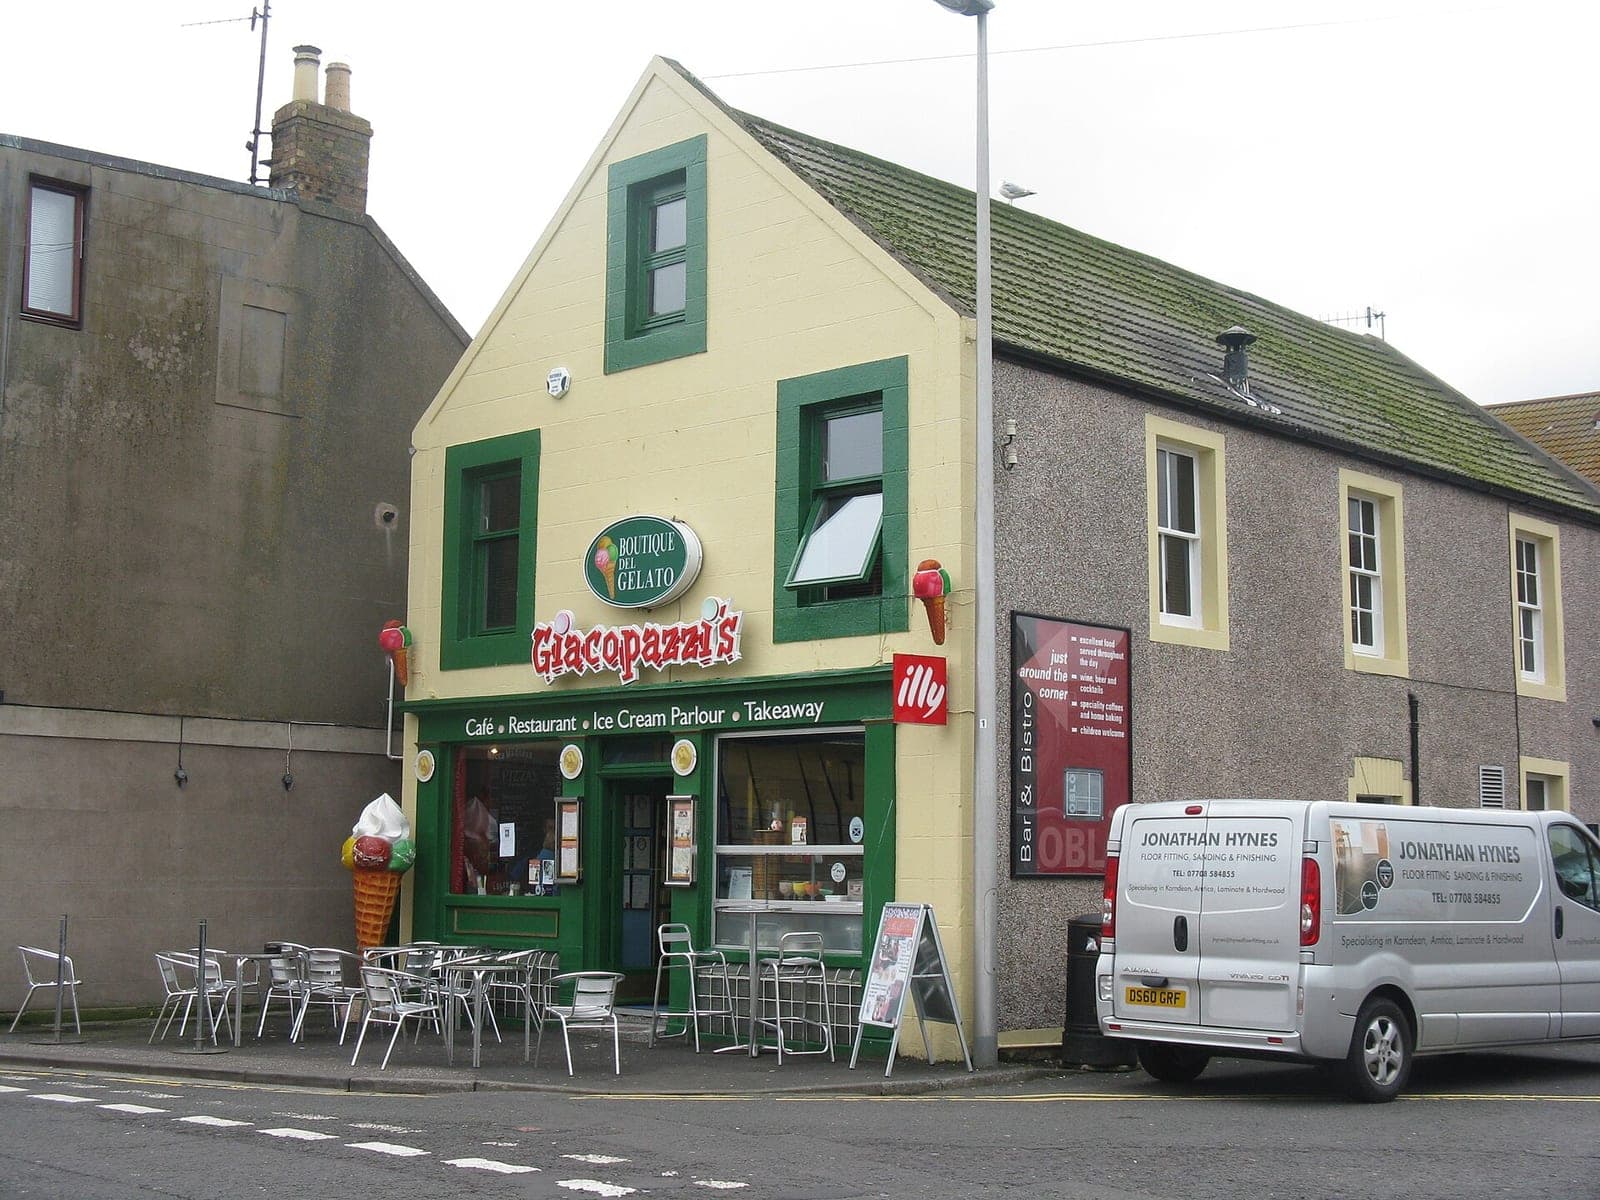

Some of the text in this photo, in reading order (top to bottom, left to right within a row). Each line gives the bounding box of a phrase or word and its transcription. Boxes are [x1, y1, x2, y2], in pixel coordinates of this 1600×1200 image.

[619, 532, 675, 557] BOUTIQUE
[618, 557, 636, 570] DEL
[617, 567, 674, 591] GELATO
[1080, 636, 1115, 648] excellent food
[1050, 649, 1068, 665] just
[1080, 648, 1124, 660] served throughout
[1080, 658, 1098, 669] the day
[1020, 667, 1068, 682] around the
[1095, 675, 1106, 684] beer
[1107, 676, 1117, 685] and
[897, 664, 945, 718] illy
[1039, 687, 1068, 700] corner
[1080, 685, 1103, 694] cocktails
[1080, 701, 1105, 711] speciality
[465, 701, 824, 736] Café Restaurant Ice Cream Parlour Takeaway
[1080, 711, 1122, 724] and home baking
[1080, 726, 1125, 737] children welcome
[1021, 691, 1032, 862] Bar & Bistro
[1141, 832, 1278, 847] JONATHAN HYNES
[1038, 826, 1105, 869] OBL
[1399, 842, 1521, 864] JONATHAN HYNES
[1140, 853, 1162, 861] FLOOR
[1192, 853, 1227, 861] SANDING
[1228, 853, 1235, 861] &
[1236, 854, 1277, 862] FINISHING
[1172, 869, 1186, 877] TEL:
[1209, 870, 1235, 878] 584855
[1402, 869, 1425, 880] FLOOR
[1454, 870, 1483, 881] SANDING
[1485, 872, 1490, 881] &
[1491, 872, 1523, 882] FINISHING
[1128, 884, 1158, 893] Specialising
[1252, 886, 1286, 894] Hardwood
[1431, 892, 1501, 904] TEL: 07708 584855
[1341, 935, 1383, 948] Specialising
[1385, 935, 1392, 945] in
[1456, 935, 1485, 945] Laminate
[1486, 935, 1492, 945] &
[1492, 934, 1524, 945] Hardwood
[1129, 988, 1181, 1005] DS60 GRF
